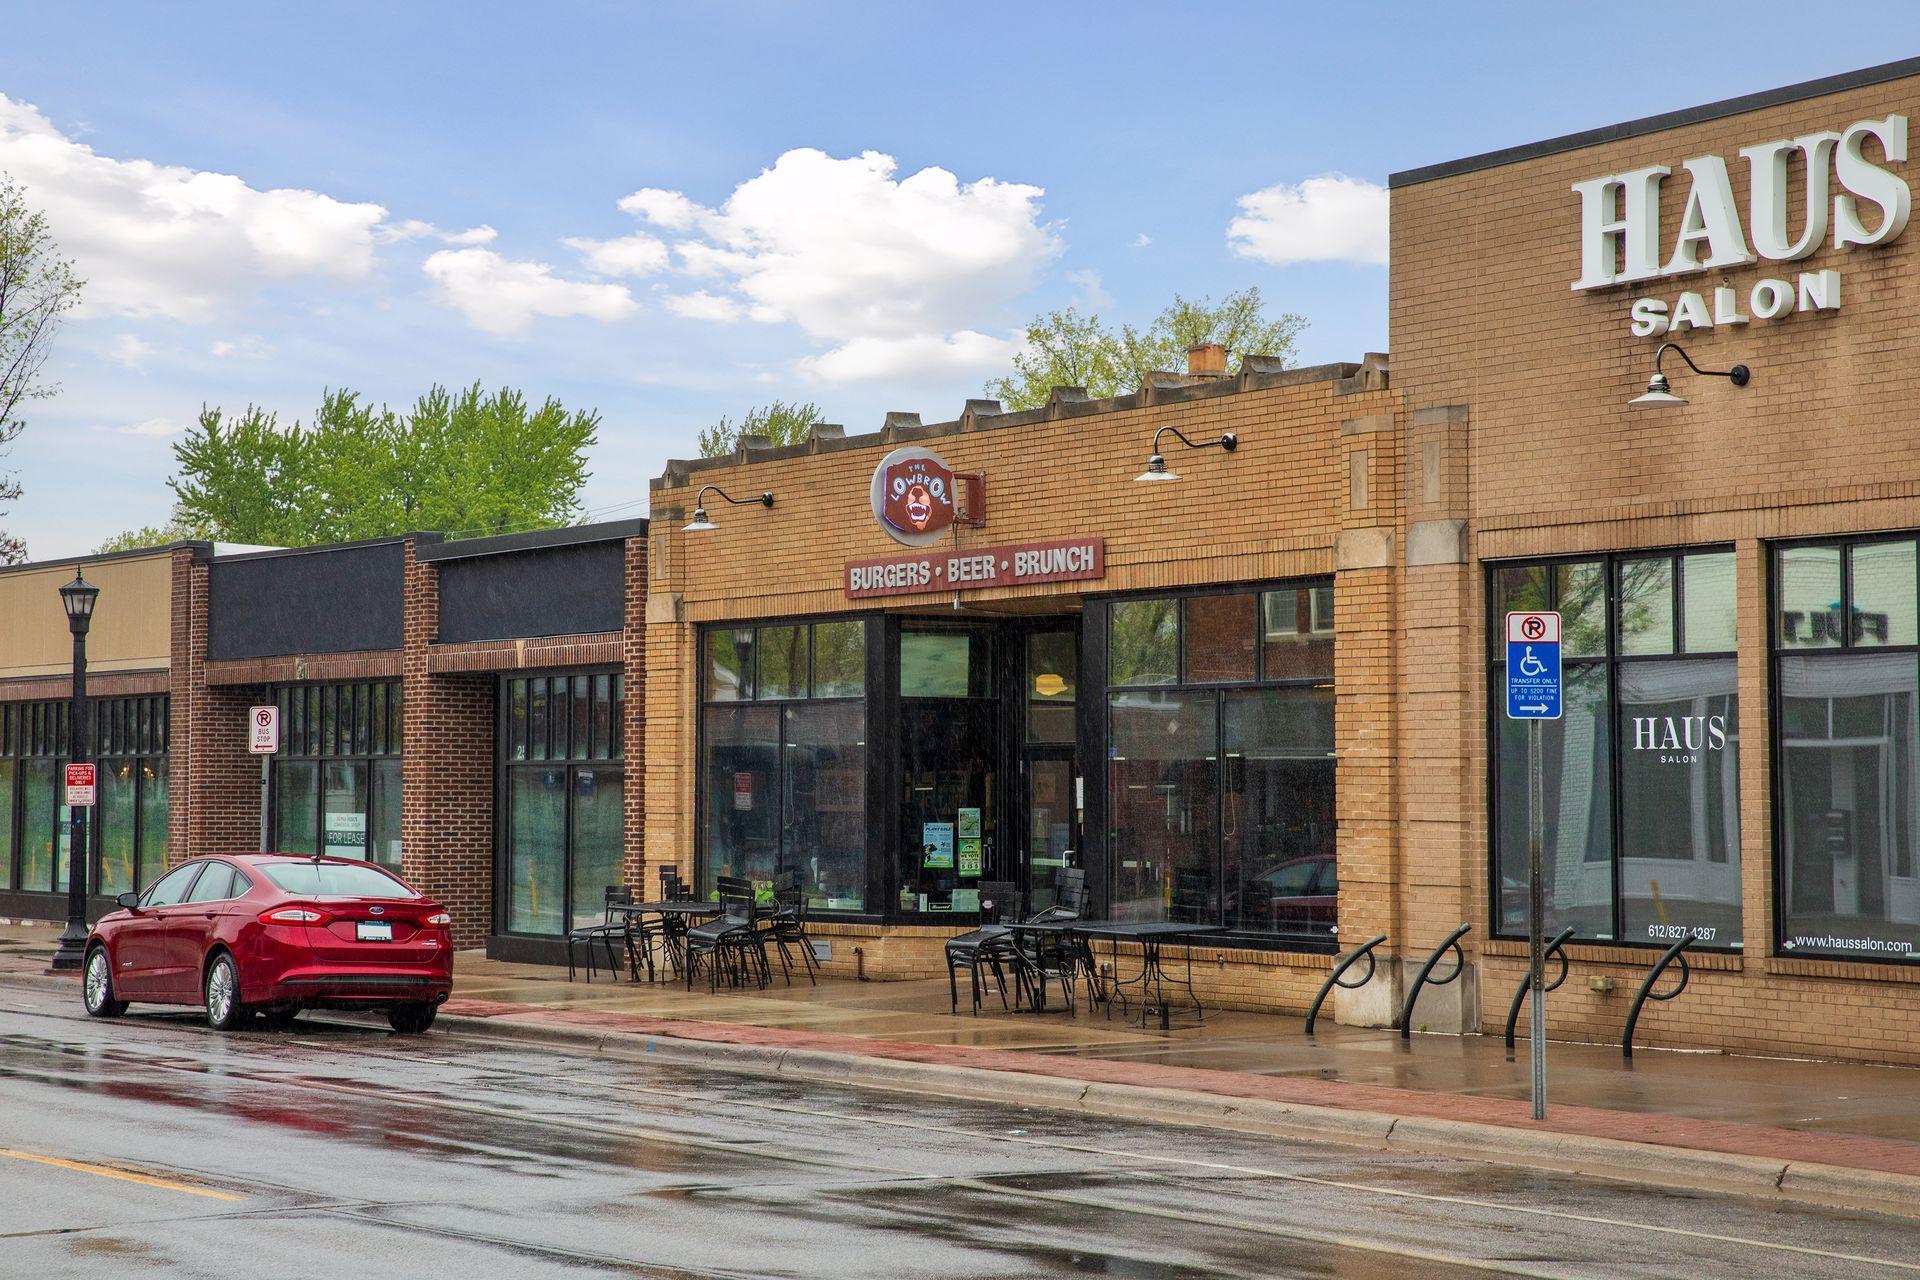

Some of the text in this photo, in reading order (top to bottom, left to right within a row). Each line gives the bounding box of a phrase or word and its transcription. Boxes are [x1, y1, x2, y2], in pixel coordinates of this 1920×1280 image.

[1571, 114, 1911, 291] HAUS
[1630, 269, 1841, 337] SALON
[908, 463, 926, 472] THE
[890, 473, 951, 505] LOWBROW
[850, 545, 1094, 591] BURGERS BEER BRUNCH
[1632, 715, 1726, 750] HAUS
[1660, 755, 1697, 763] SALON
[328, 832, 365, 844] FOR LEASE
[1795, 934, 1912, 952] www.haussalon.com
